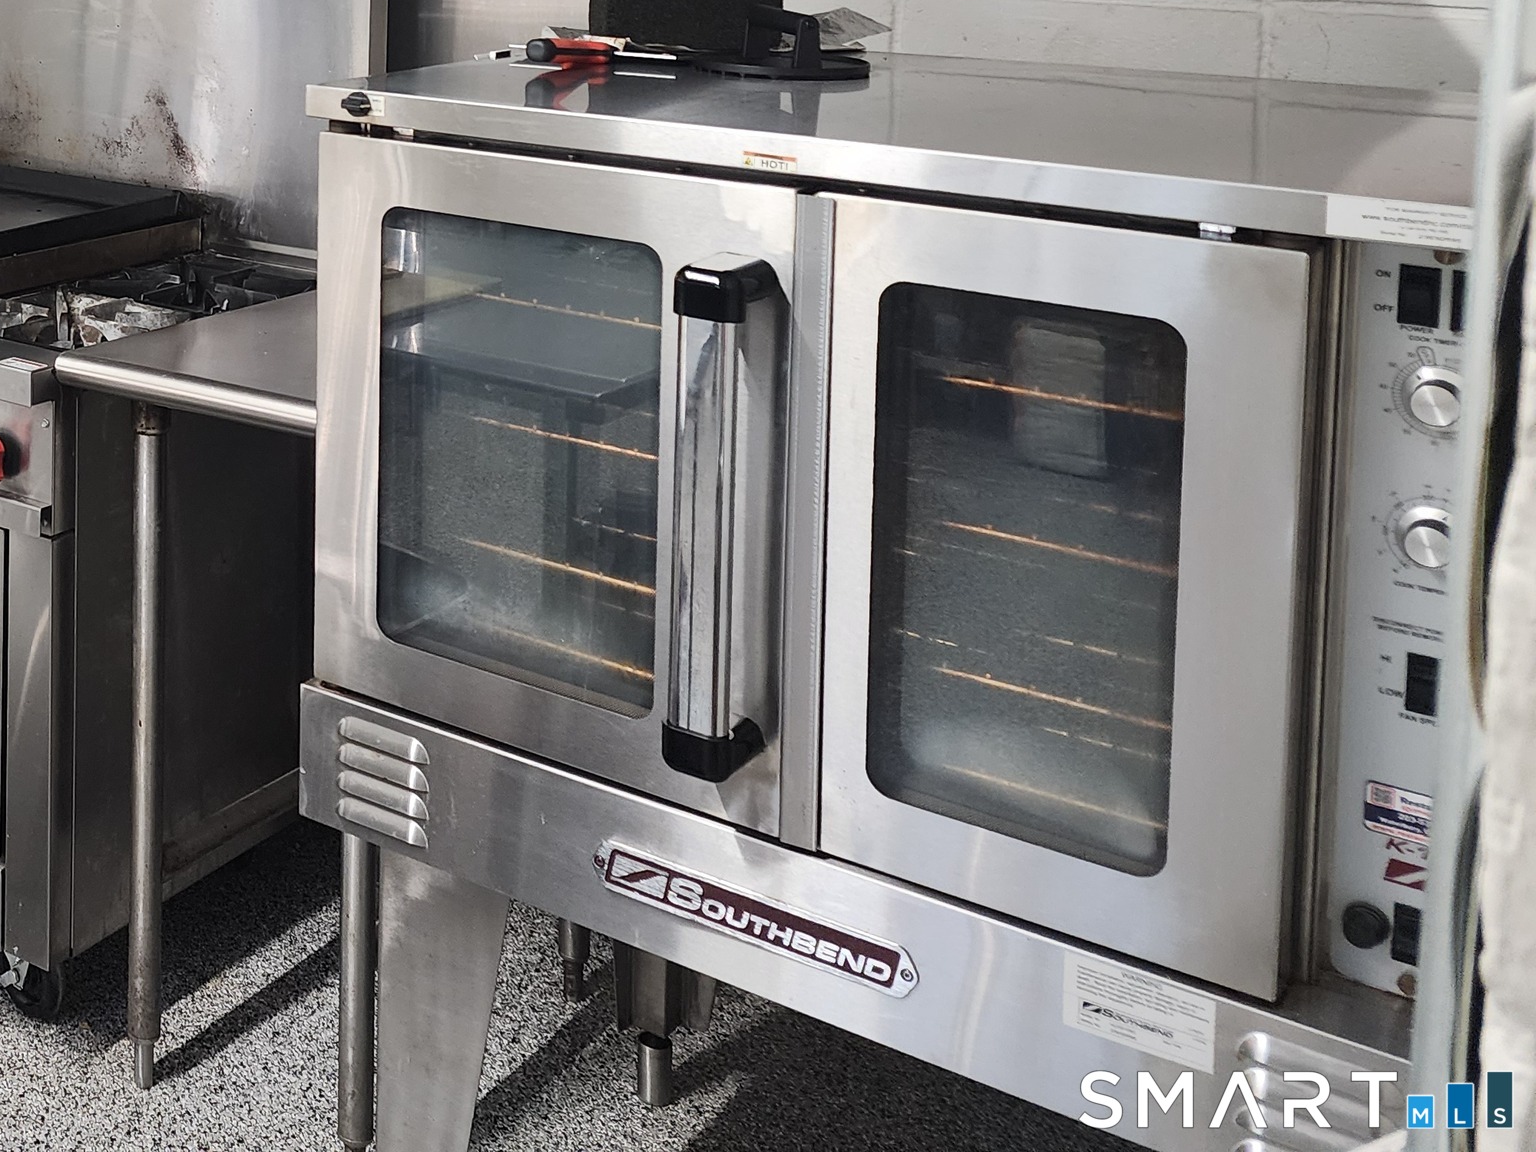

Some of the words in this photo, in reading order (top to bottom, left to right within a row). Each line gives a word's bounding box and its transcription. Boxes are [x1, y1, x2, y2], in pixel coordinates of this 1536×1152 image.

[760, 159, 789, 171] HOT!
[1375, 269, 1392, 278] ON
[1374, 303, 1394, 313] OFF
[1378, 687, 1405, 699] LOW
[667, 877, 891, 982] SOUTHBEND
